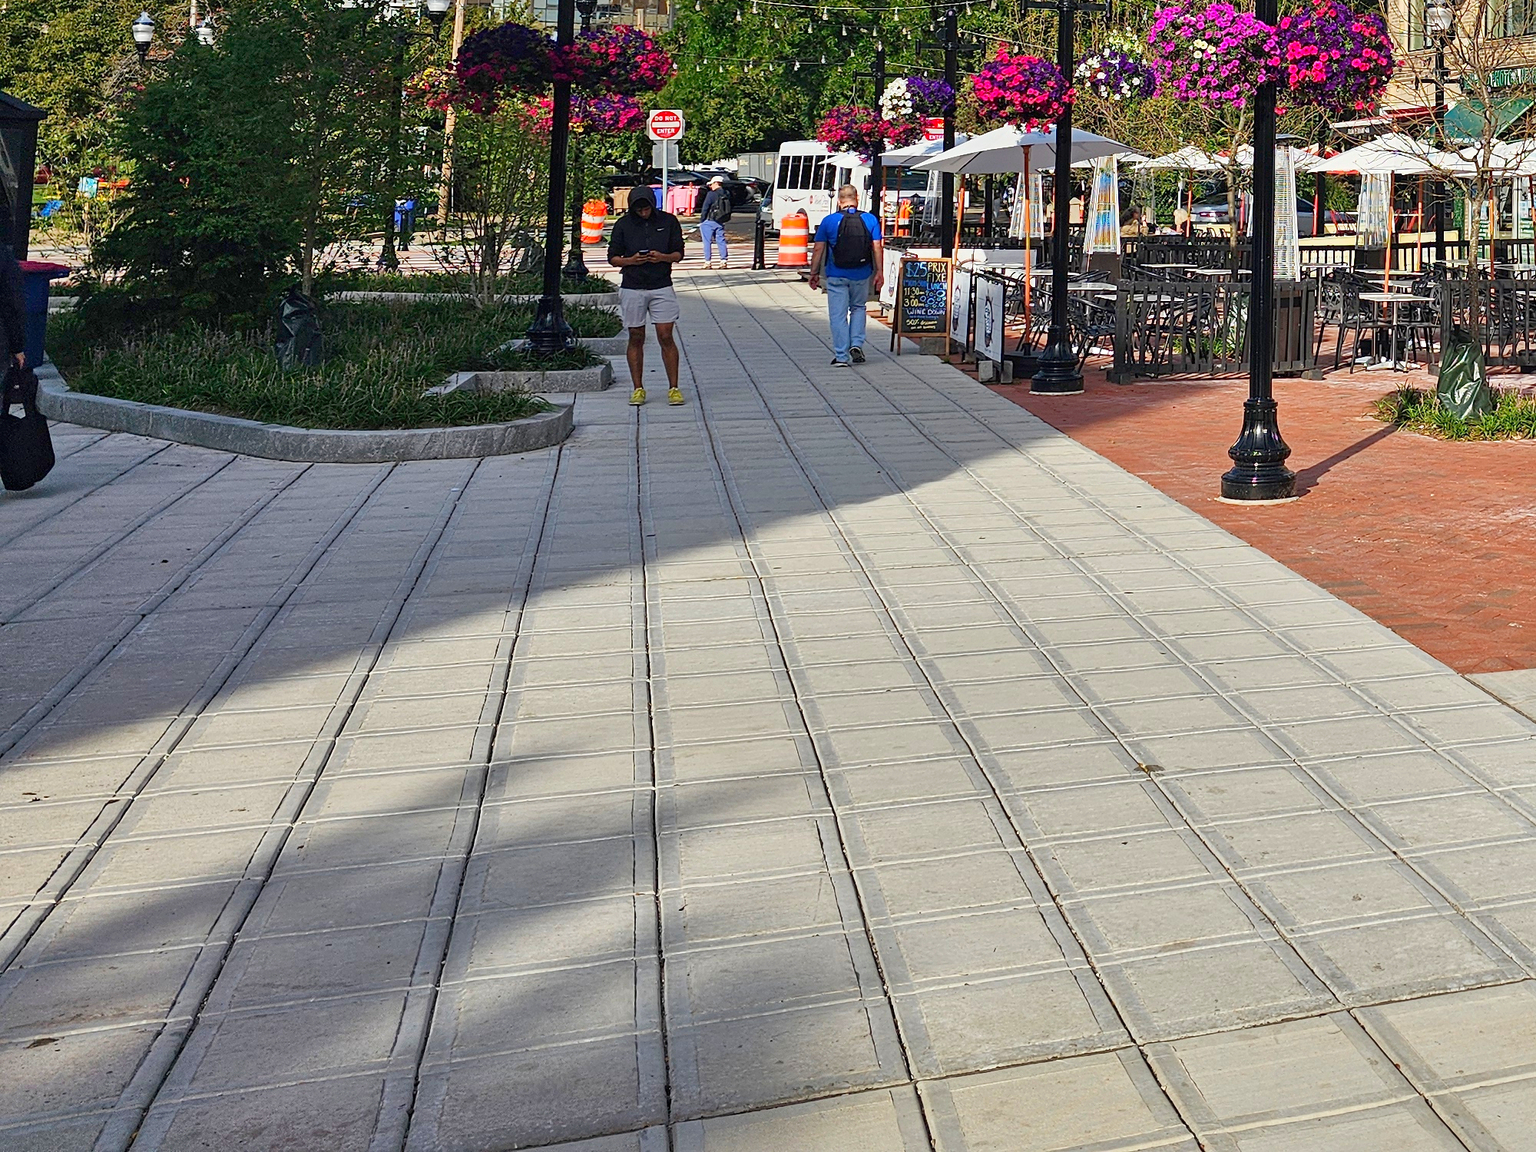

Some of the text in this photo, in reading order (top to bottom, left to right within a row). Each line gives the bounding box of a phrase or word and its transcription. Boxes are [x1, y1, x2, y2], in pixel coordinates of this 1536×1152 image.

[906, 262, 946, 277] $25 PRIX
[927, 273, 946, 282] FIXE
